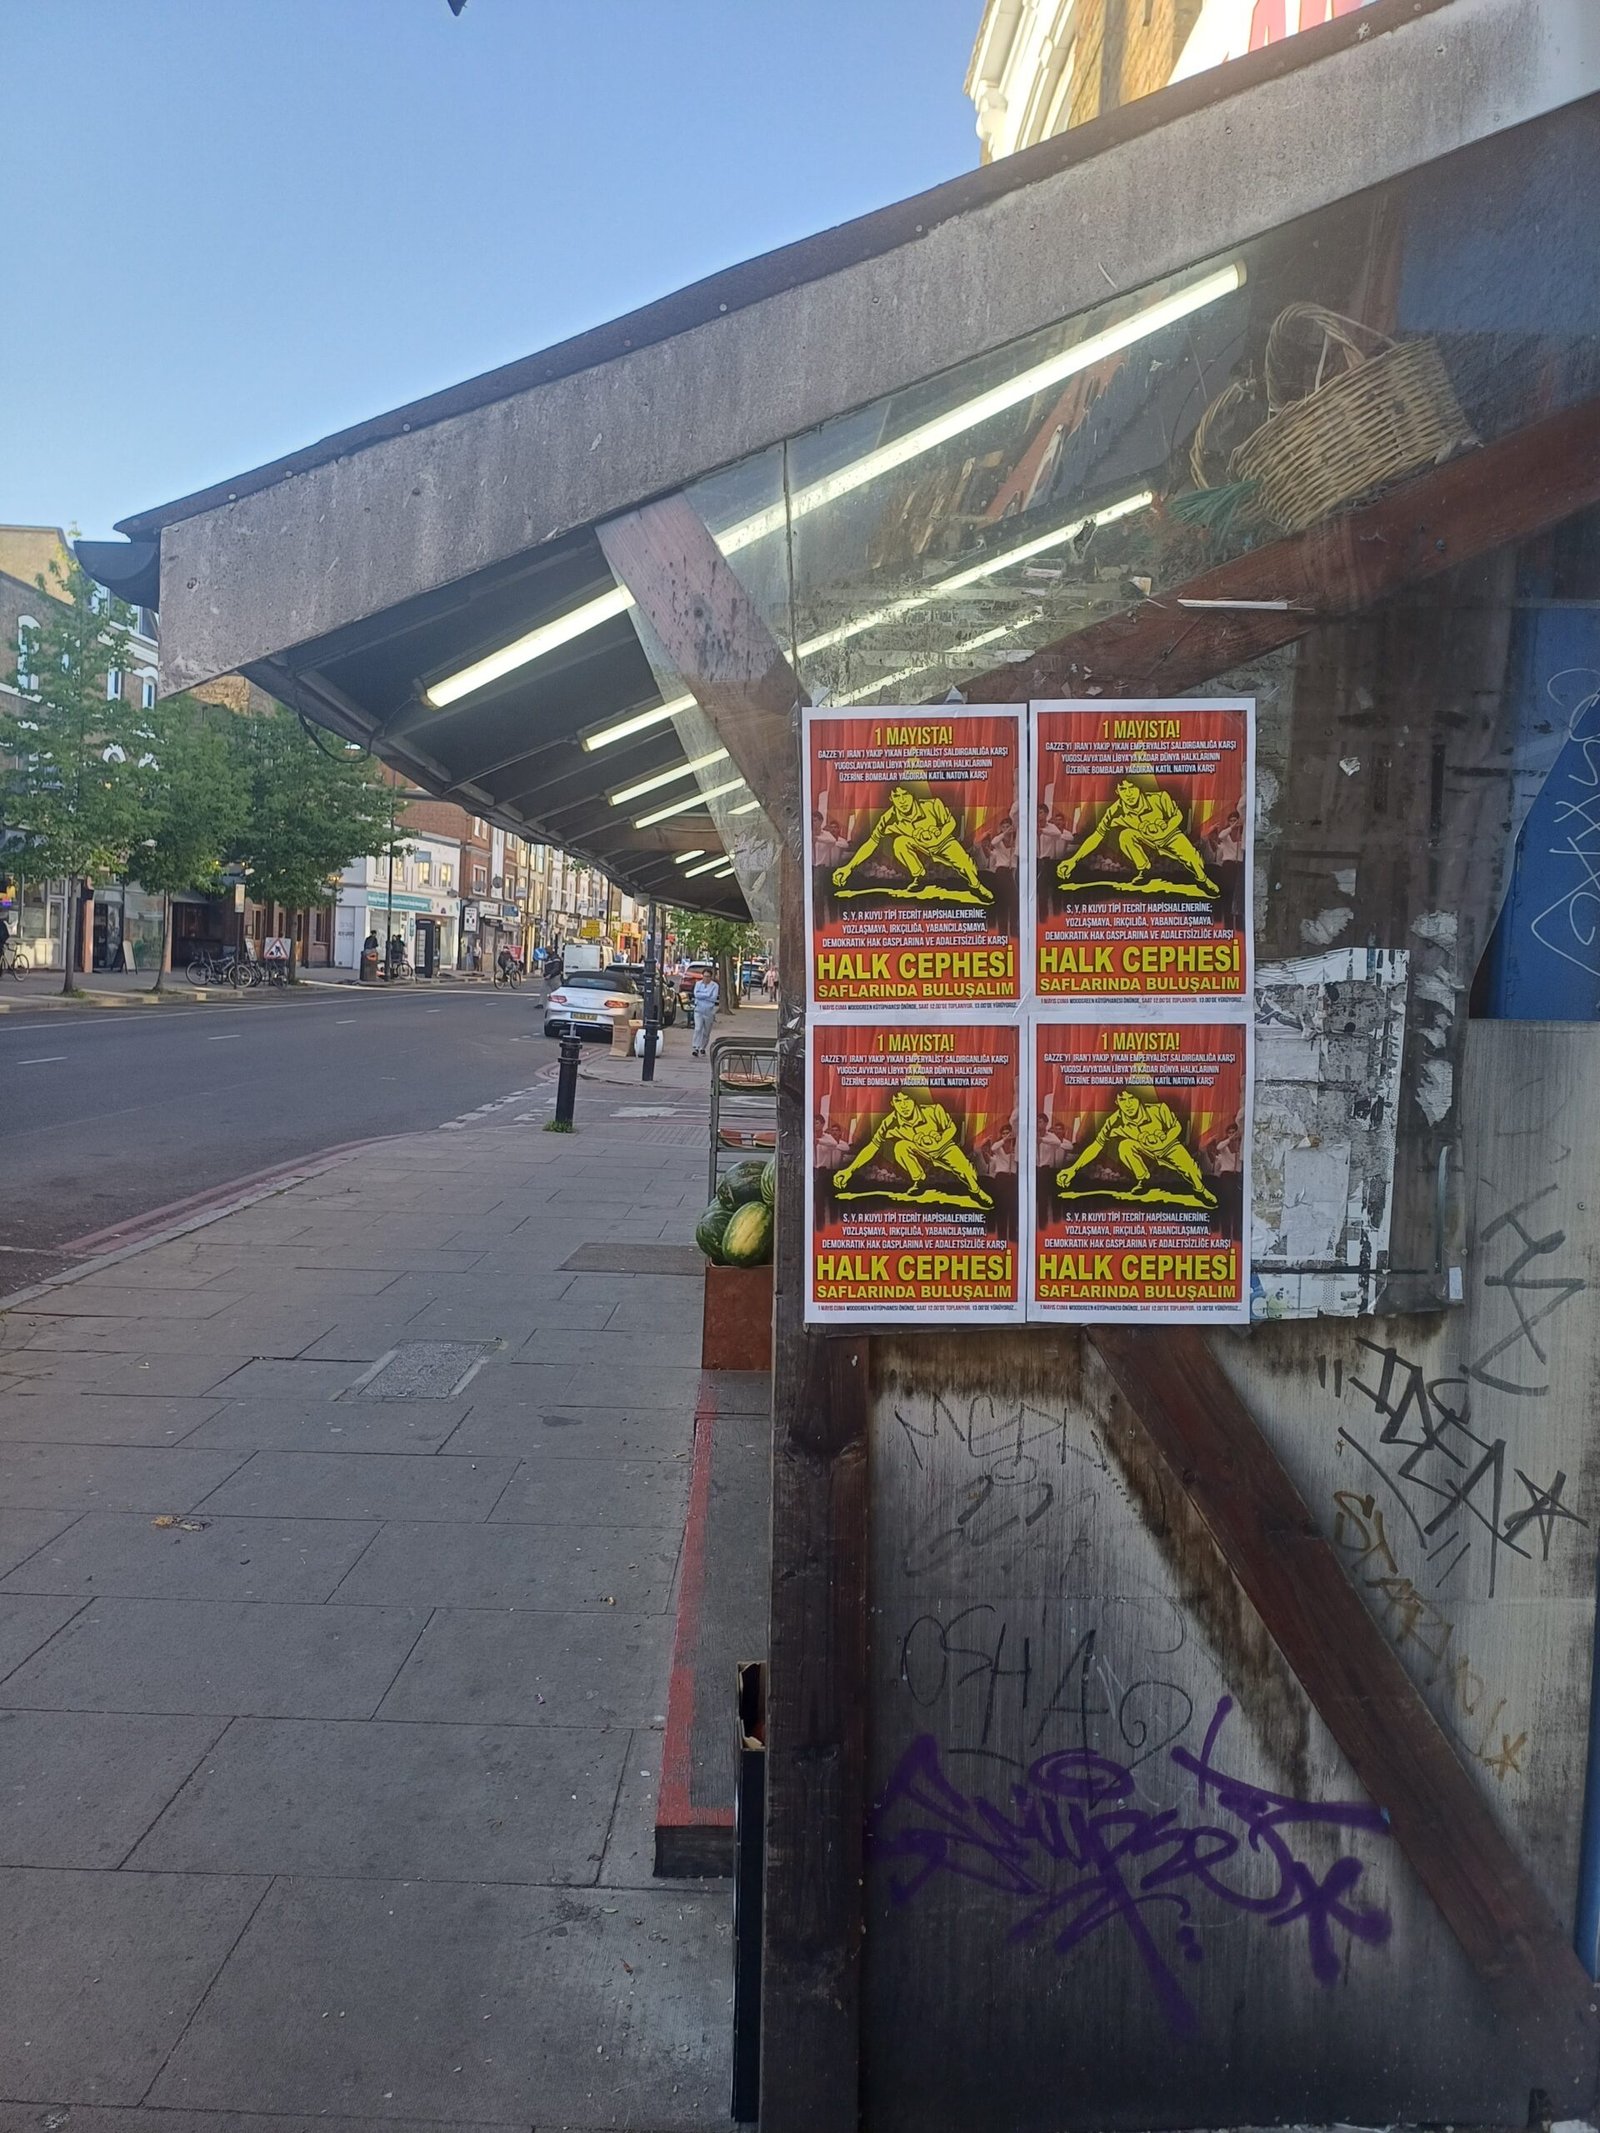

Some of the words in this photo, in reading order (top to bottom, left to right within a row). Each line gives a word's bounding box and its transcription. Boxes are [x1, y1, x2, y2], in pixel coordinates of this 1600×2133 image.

[875, 727, 881, 745] 1
[886, 726, 953, 745] MAYISTA!
[1102, 721, 1108, 738] 1
[1113, 719, 1180, 738] MAYISTA!
[946, 770, 969, 779] NATOYA
[1173, 764, 1197, 772] NATOYA
[858, 911, 864, 920] R
[864, 911, 883, 920] KUYU
[884, 909, 897, 920] TİPİ
[898, 909, 921, 920] TECRİT
[922, 907, 987, 920] HAPİSHALENERİNE;
[1082, 904, 1088, 913] R
[1088, 904, 1107, 913] KUYU
[1109, 902, 1121, 913] TİPİ
[1122, 902, 1146, 913] TECRİT
[1147, 901, 1213, 913] HAPİSHALENERİNE;
[866, 938, 882, 947] HAK
[882, 937, 924, 946] GASPLARINA
[926, 937, 934, 945] VE
[935, 934, 987, 945] ADALETSİZLİĞE
[987, 935, 1008, 946] KARŞI
[1090, 931, 1105, 940] HAK
[1106, 930, 1148, 940] GASPLARINA
[1150, 930, 1159, 939] VE
[1160, 928, 1212, 939] ADALETSİZLİĞE
[1213, 929, 1234, 940] KARŞI
[817, 953, 891, 980] HALK
[898, 945, 1014, 979] CEPHESİ
[1040, 947, 1114, 973] HALK
[1122, 939, 1239, 972] CEPHESİ
[818, 983, 918, 998] SAFLARINDA
[922, 982, 1014, 999] BULUŞALIM
[1040, 977, 1141, 991] SAFLARINDA
[1146, 976, 1239, 993] BULUŞALIM
[877, 1034, 883, 1051] 1
[888, 1033, 954, 1051] MAYISTA!
[1102, 1032, 1108, 1050] 1
[1113, 1032, 1180, 1050] MAYISTA!
[1172, 1076, 1196, 1084] NATOYA
[858, 1214, 863, 1222] R
[864, 1213, 883, 1222] KUYU
[884, 1212, 896, 1222] TİPİ
[897, 1212, 921, 1222] TECRİT
[922, 1212, 986, 1223] HAPİSHALENERİNE;
[1081, 1213, 1087, 1222] R
[1087, 1213, 1106, 1222] KUYU
[1108, 1211, 1120, 1222] TİPİ
[1121, 1211, 1145, 1222] TECRİT
[1146, 1211, 1210, 1223] HAPİSHALENERİNE;
[866, 1240, 881, 1248] HAK
[882, 1240, 923, 1248] GASPLARINA
[925, 1240, 933, 1248] VE
[934, 1238, 985, 1248] ADALETSİZLİĞE
[986, 1239, 1006, 1250] KARŞI
[1089, 1239, 1104, 1248] HAK
[1105, 1239, 1147, 1248] GASPLARINA
[1149, 1239, 1157, 1248] VE
[1158, 1237, 1210, 1248] ADALETSİZLİĞE
[1210, 1239, 1231, 1250] KARŞI
[817, 1255, 889, 1280] HALK
[898, 1249, 1012, 1280] CEPHESİ
[1039, 1254, 1113, 1280] HALK
[1121, 1248, 1236, 1280] CEPHESİ
[817, 1285, 916, 1298] SAFLARINDA
[921, 1285, 1012, 1301] BULUŞALIM
[1040, 1285, 1140, 1297] SAFLARINDA
[1144, 1285, 1236, 1301] BULUŞALIM
